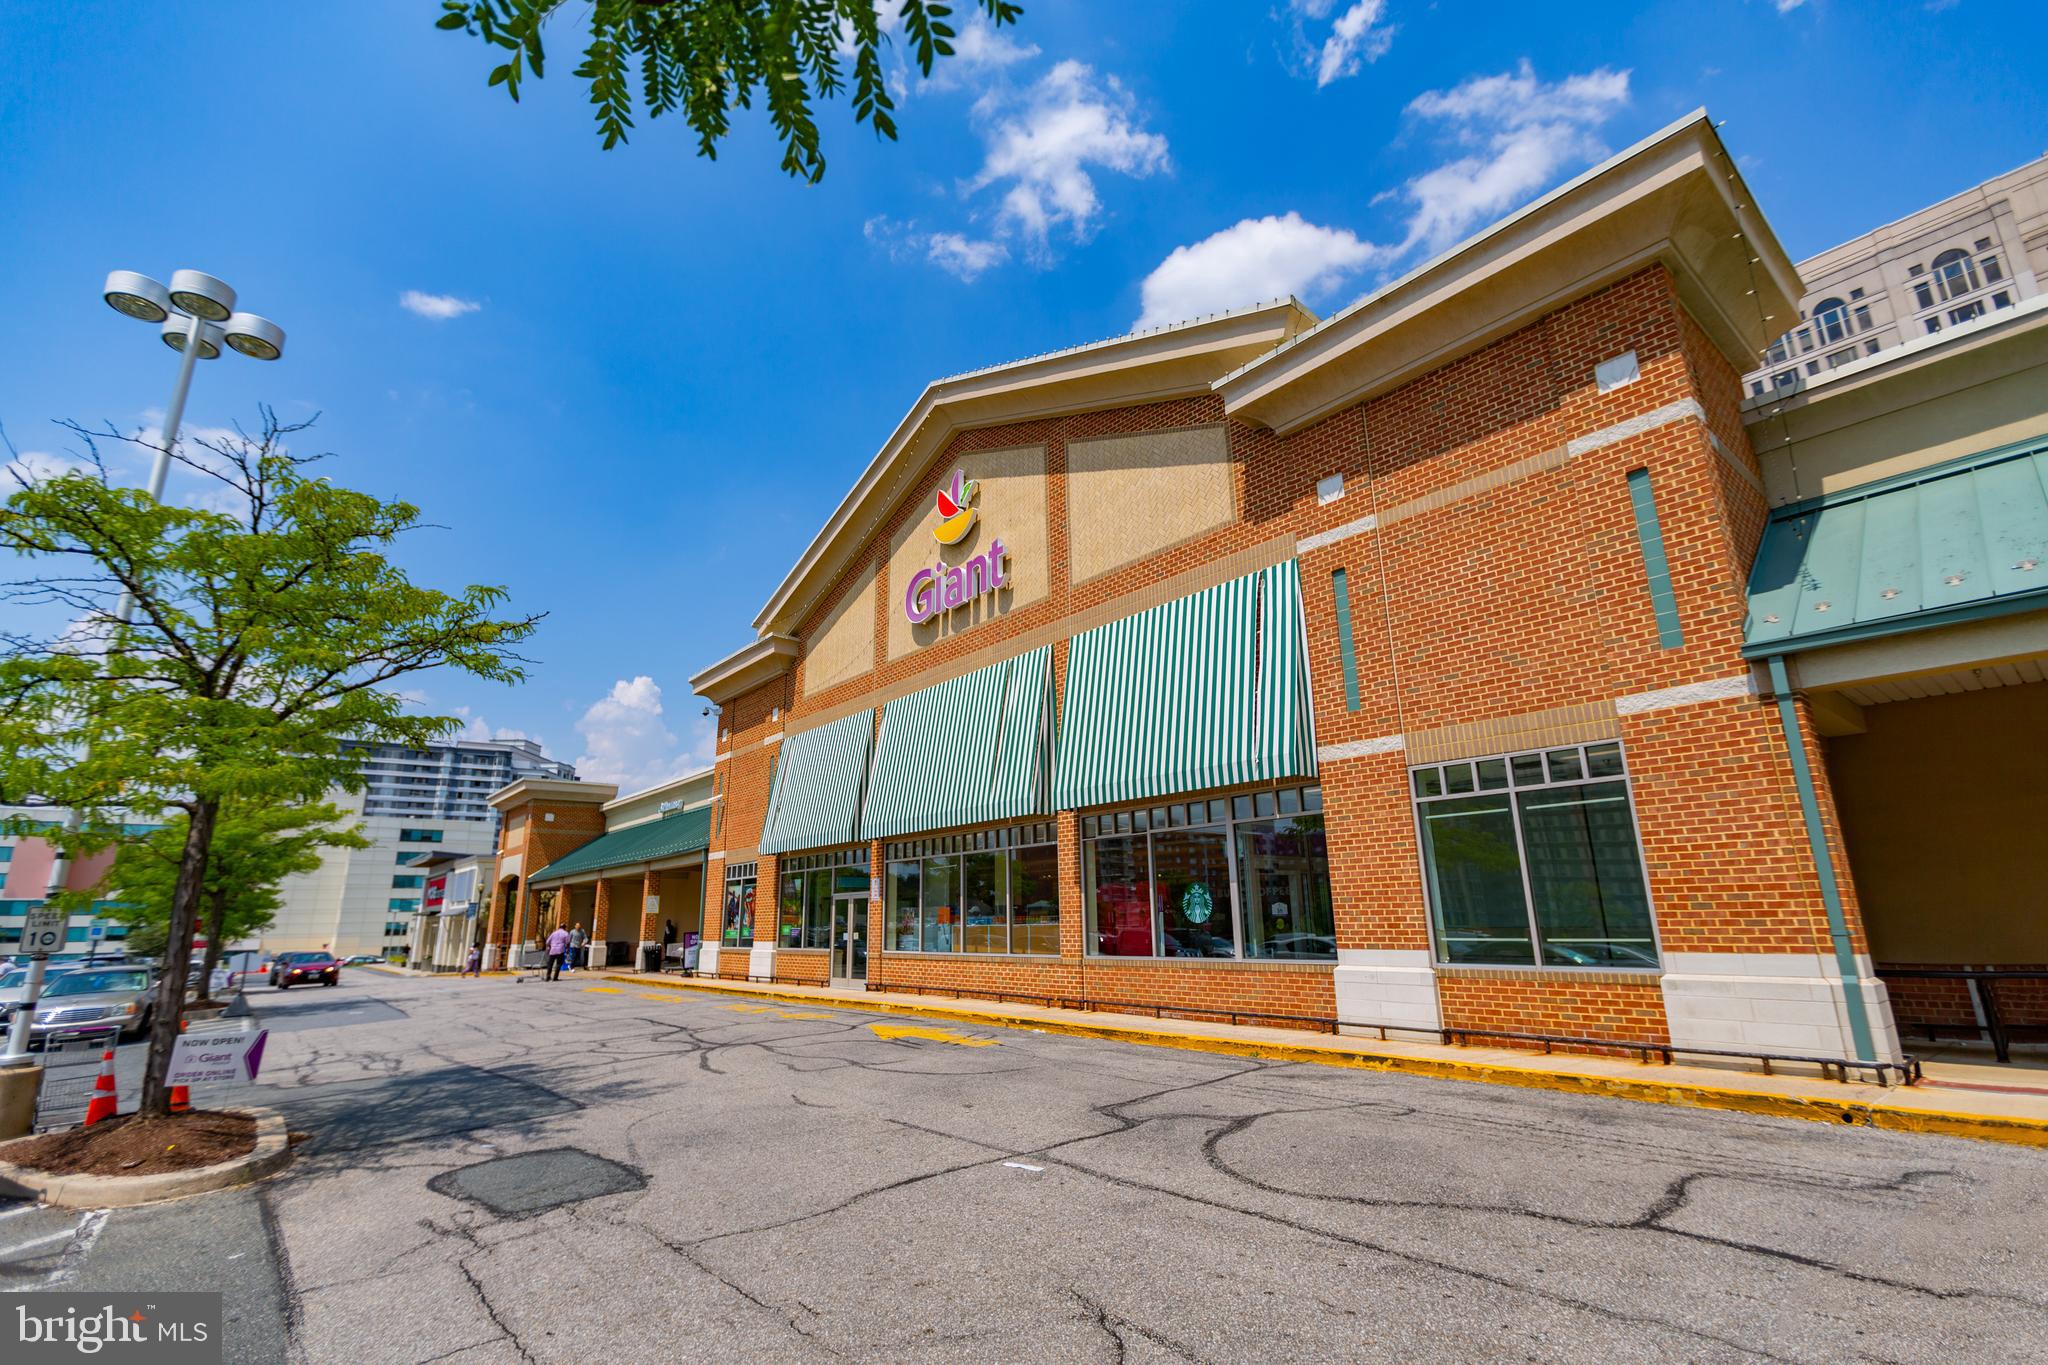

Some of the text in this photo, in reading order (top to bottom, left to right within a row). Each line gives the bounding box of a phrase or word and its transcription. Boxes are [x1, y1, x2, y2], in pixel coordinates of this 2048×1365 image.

[904, 537, 1008, 623] Giant
[30, 932, 56, 946] 10
[182, 1039, 208, 1047] NOW
[199, 1053, 232, 1062] Giant
